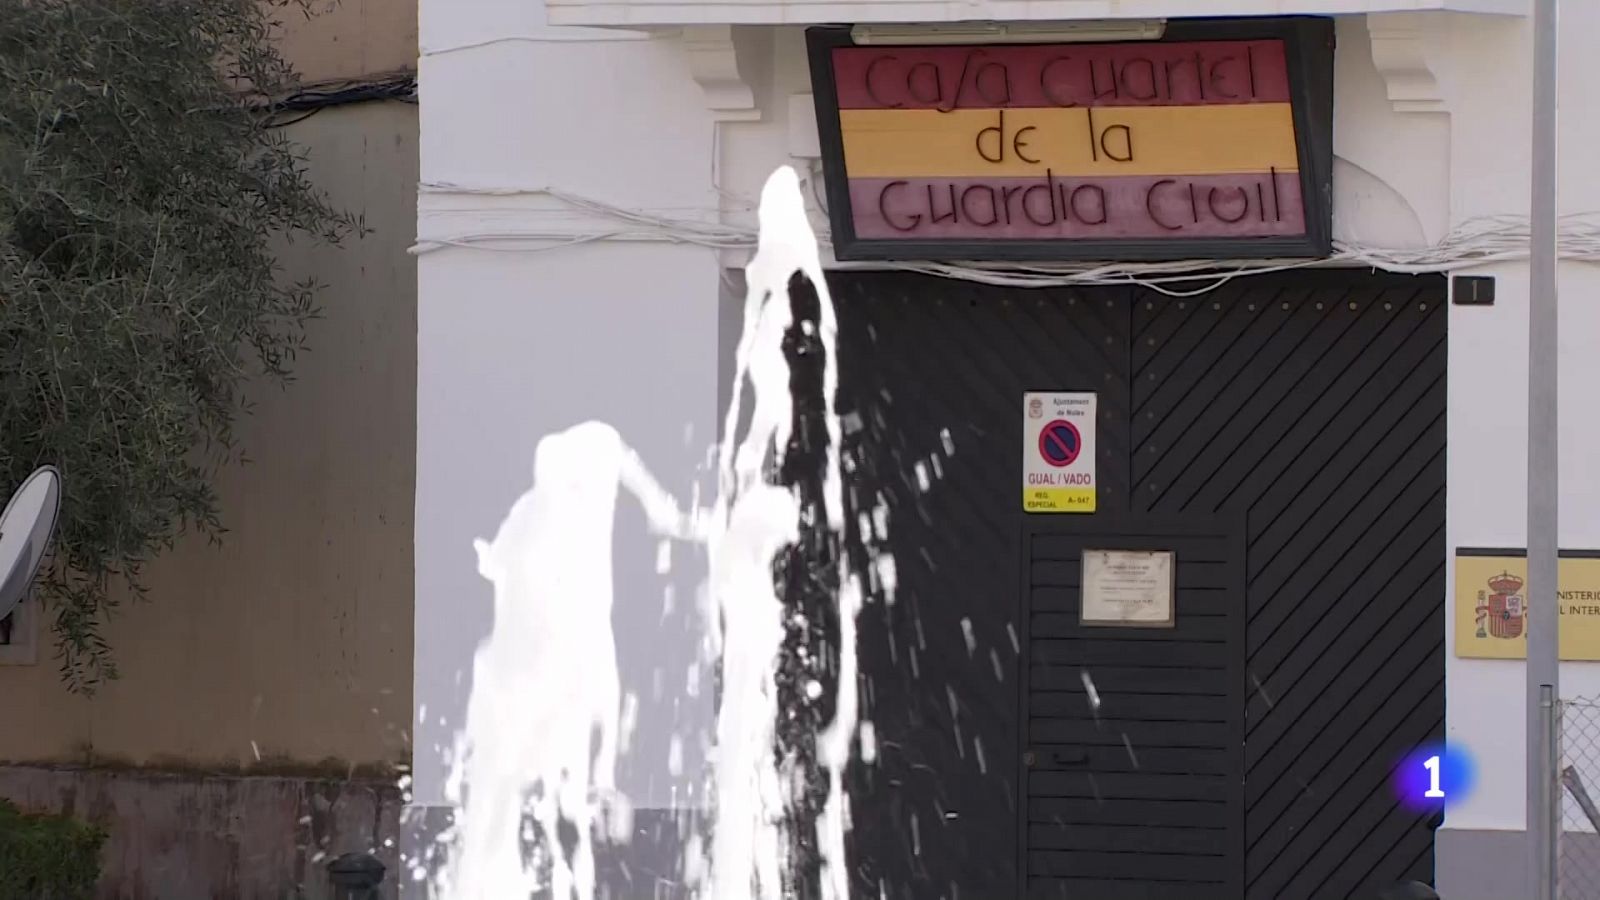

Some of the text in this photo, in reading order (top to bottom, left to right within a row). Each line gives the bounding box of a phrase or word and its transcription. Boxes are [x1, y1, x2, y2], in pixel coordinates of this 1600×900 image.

[1040, 45, 1257, 107] Cuartel
[975, 107, 1134, 164] de la
[878, 165, 1281, 232] Guardia Civil
[1053, 397, 1089, 406] Ajuntament
[1028, 472, 1056, 485] GUAL
[1063, 472, 1092, 485] VADO
